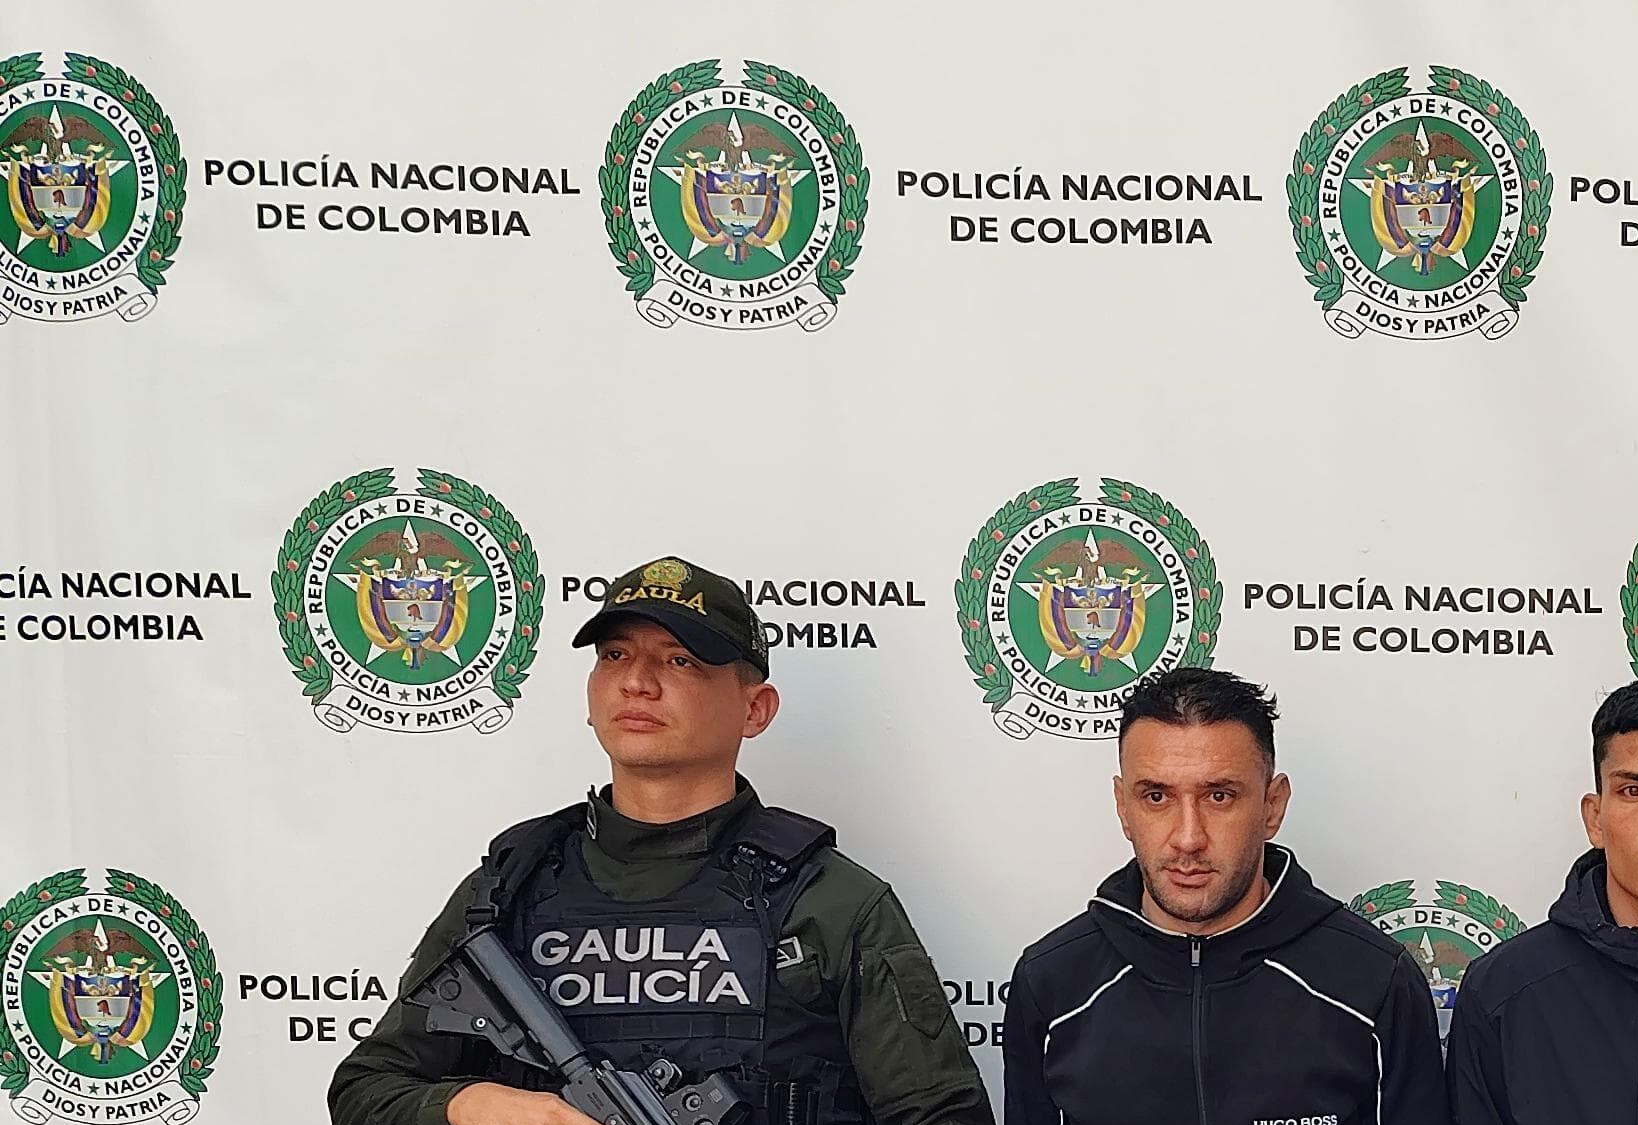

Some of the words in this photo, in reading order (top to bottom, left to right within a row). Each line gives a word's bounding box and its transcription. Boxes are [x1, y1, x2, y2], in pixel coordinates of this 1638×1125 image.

[43, 83, 71, 98] DE
[93, 95, 155, 202] COLOMBIA
[722, 90, 751, 107] DE
[773, 105, 836, 211] COLOMBIA
[1409, 98, 1437, 114] DE
[1458, 110, 1519, 218] COLOMBIA
[205, 155, 358, 187] POLICÍA
[372, 163, 580, 194] NACIONAL
[898, 167, 1050, 200] POLICÍA
[1063, 175, 1262, 201] NACIONAL
[257, 204, 305, 229] DE
[319, 206, 530, 236] COLOMBIA
[951, 216, 998, 242] DE
[1011, 218, 1212, 244] COLOMBIA
[62, 226, 148, 290] NACIONAL
[738, 235, 829, 298] NACIONAL
[1423, 242, 1512, 308] NACIONAL
[63, 286, 128, 314] PATRIA
[739, 294, 808, 322] PATRIA
[1424, 303, 1490, 333] PATRIA
[397, 498, 426, 514] DE
[448, 512, 512, 617] COLOMBIA
[1079, 508, 1107, 523] DE
[1129, 520, 1190, 624] COLOMBIA
[62, 573, 251, 598] NACIONAL
[1245, 578, 1393, 610] POLICÍA
[1406, 586, 1602, 613] NACIONAL
[18, 615, 203, 640] COLOMBIA
[1295, 626, 1340, 650] DE
[1353, 627, 1553, 655] COLOMBIA
[415, 640, 505, 702] NACIONAL
[416, 698, 484, 726] PATRIA
[1414, 910, 1442, 925] DE
[86, 898, 113, 913] DE
[134, 911, 194, 1012] COLOMBIA
[531, 927, 731, 967] GAULA
[240, 969, 387, 1000] POLICÍA
[290, 1017, 336, 1041] DE
[106, 1035, 188, 1096] NACIONAL
[107, 1092, 170, 1119] PATRIA
